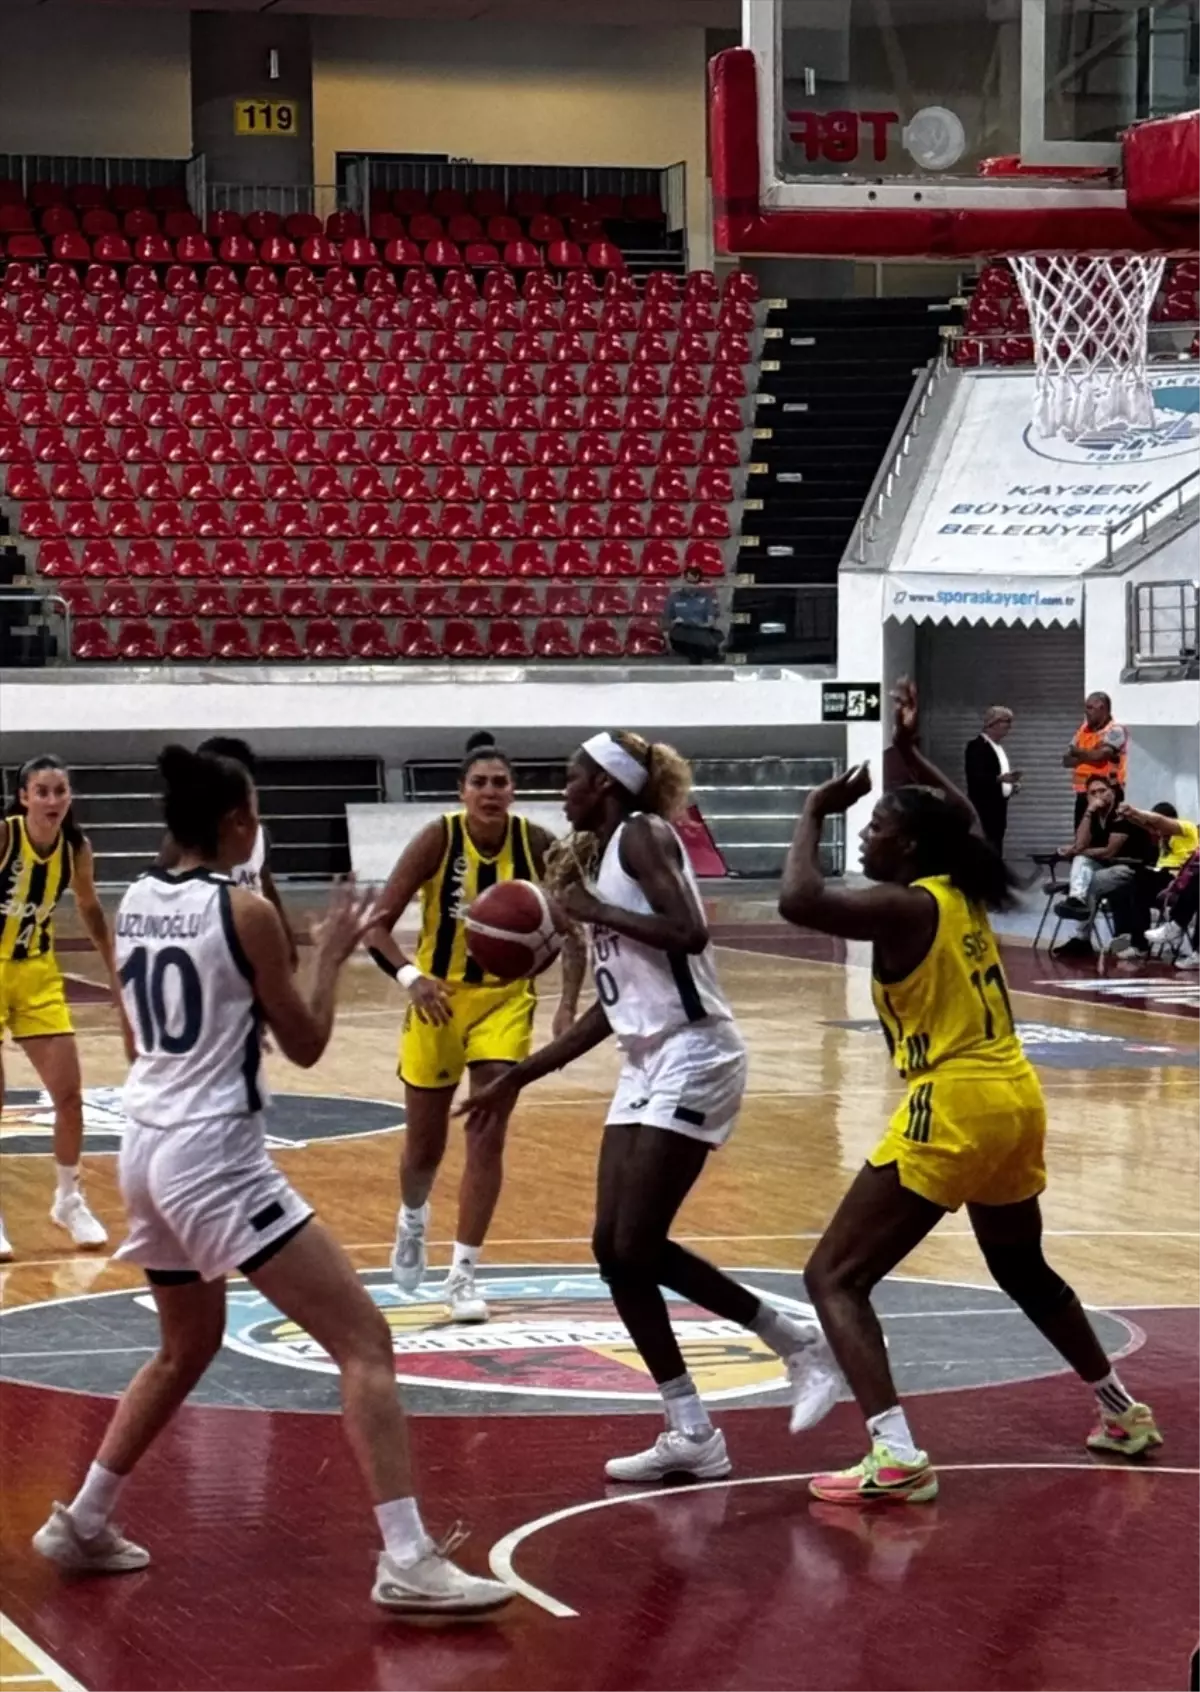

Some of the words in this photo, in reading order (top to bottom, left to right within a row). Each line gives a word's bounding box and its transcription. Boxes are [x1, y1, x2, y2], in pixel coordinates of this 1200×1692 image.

[243, 105, 293, 130] 119
[1007, 481, 1152, 496] KAYSERİ
[16, 923, 35, 949] 4
[118, 945, 204, 1054] 10
